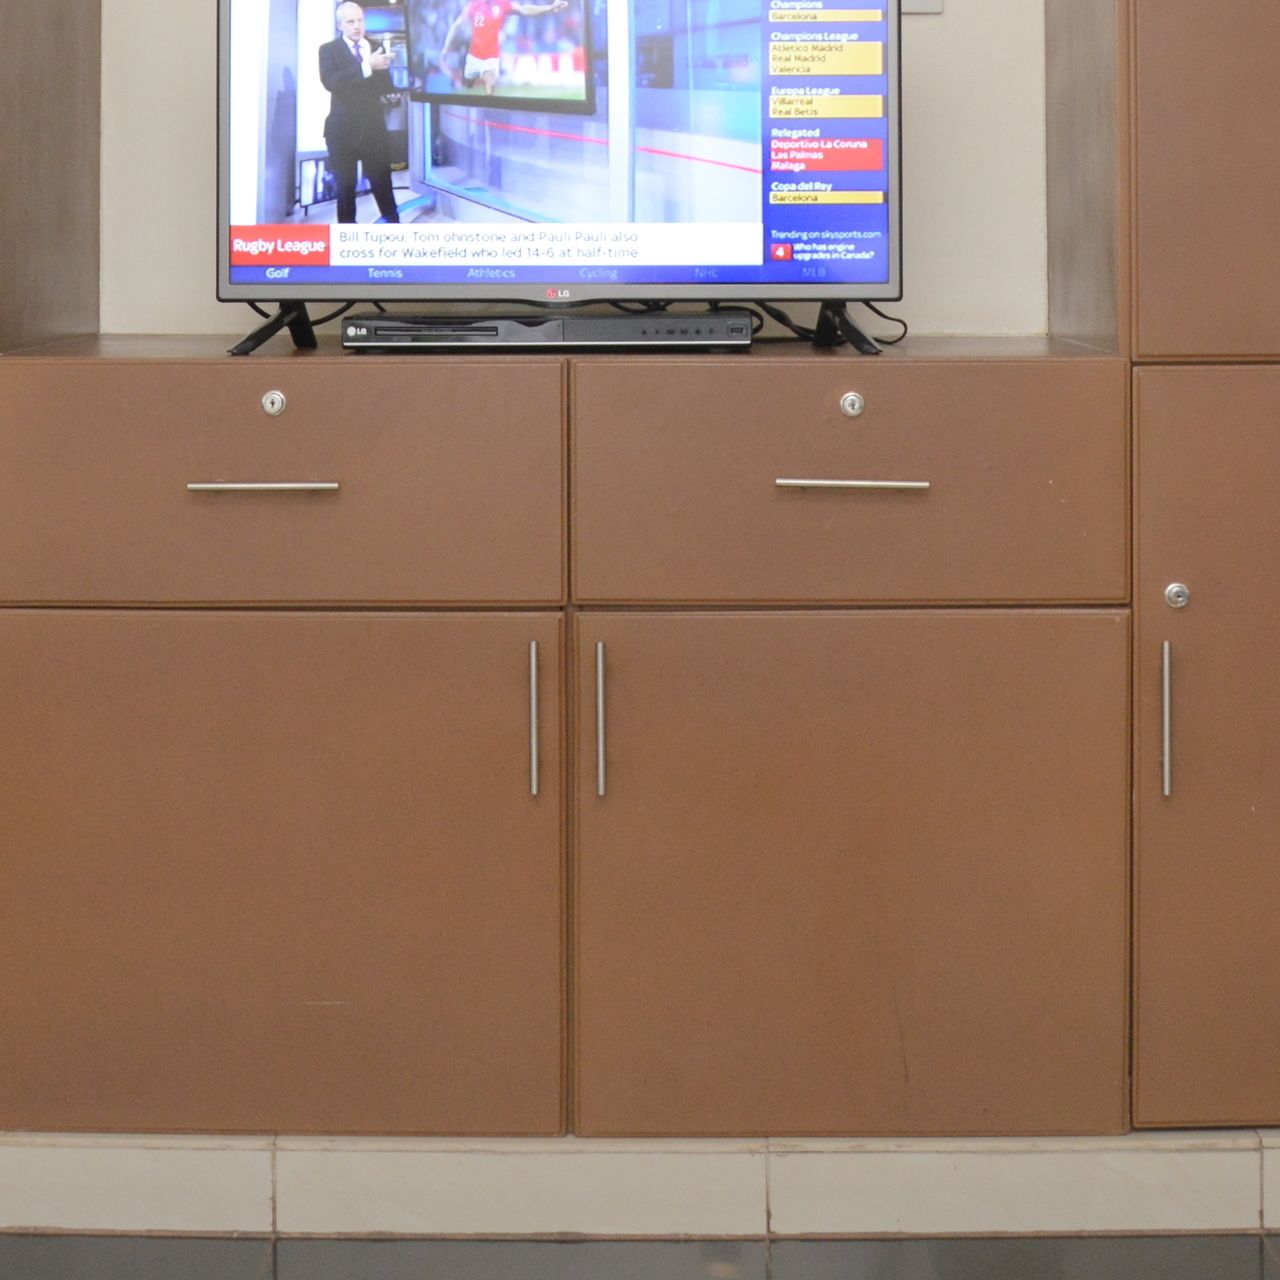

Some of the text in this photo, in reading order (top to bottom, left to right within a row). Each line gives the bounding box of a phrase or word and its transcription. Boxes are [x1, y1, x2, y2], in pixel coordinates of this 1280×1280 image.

[770, 0, 823, 10] Champions
[772, 11, 818, 20] Barcelona
[770, 31, 859, 42] Champions League
[772, 44, 843, 52] Atletico Madrid
[772, 54, 826, 62] Real Madrid
[772, 65, 811, 73] Valencia
[770, 86, 840, 96] Europa League
[772, 97, 813, 106] Villarreal
[772, 108, 818, 116] Real Betis
[770, 128, 820, 139] Relegated
[770, 139, 868, 149] Deportivo La Coruna
[770, 151, 823, 160] Las Palmas
[770, 161, 806, 172] Malaga
[770, 181, 832, 192] Copa del Rey
[772, 193, 818, 202] Barcelona
[339, 231, 359, 242] Bill
[364, 231, 407, 245] Tupou,
[412, 231, 439, 242] Tom
[510, 231, 535, 242] and
[539, 231, 571, 242] Pauli
[575, 231, 607, 242] Pauli
[611, 231, 639, 242] also
[770, 230, 809, 240] Trending
[821, 230, 882, 240] skysports.com
[233, 238, 326, 256] Rugby League
[775, 246, 785, 257] 4
[793, 243, 855, 252] Who has engine
[339, 246, 639, 259] cross for Wakefield who led 14-6 at half-time
[793, 250, 875, 261] upgrades in Canada?
[265, 267, 290, 279] Golf
[367, 267, 403, 279] Tennis
[467, 268, 516, 279] Athletics
[578, 267, 618, 281] Cycling
